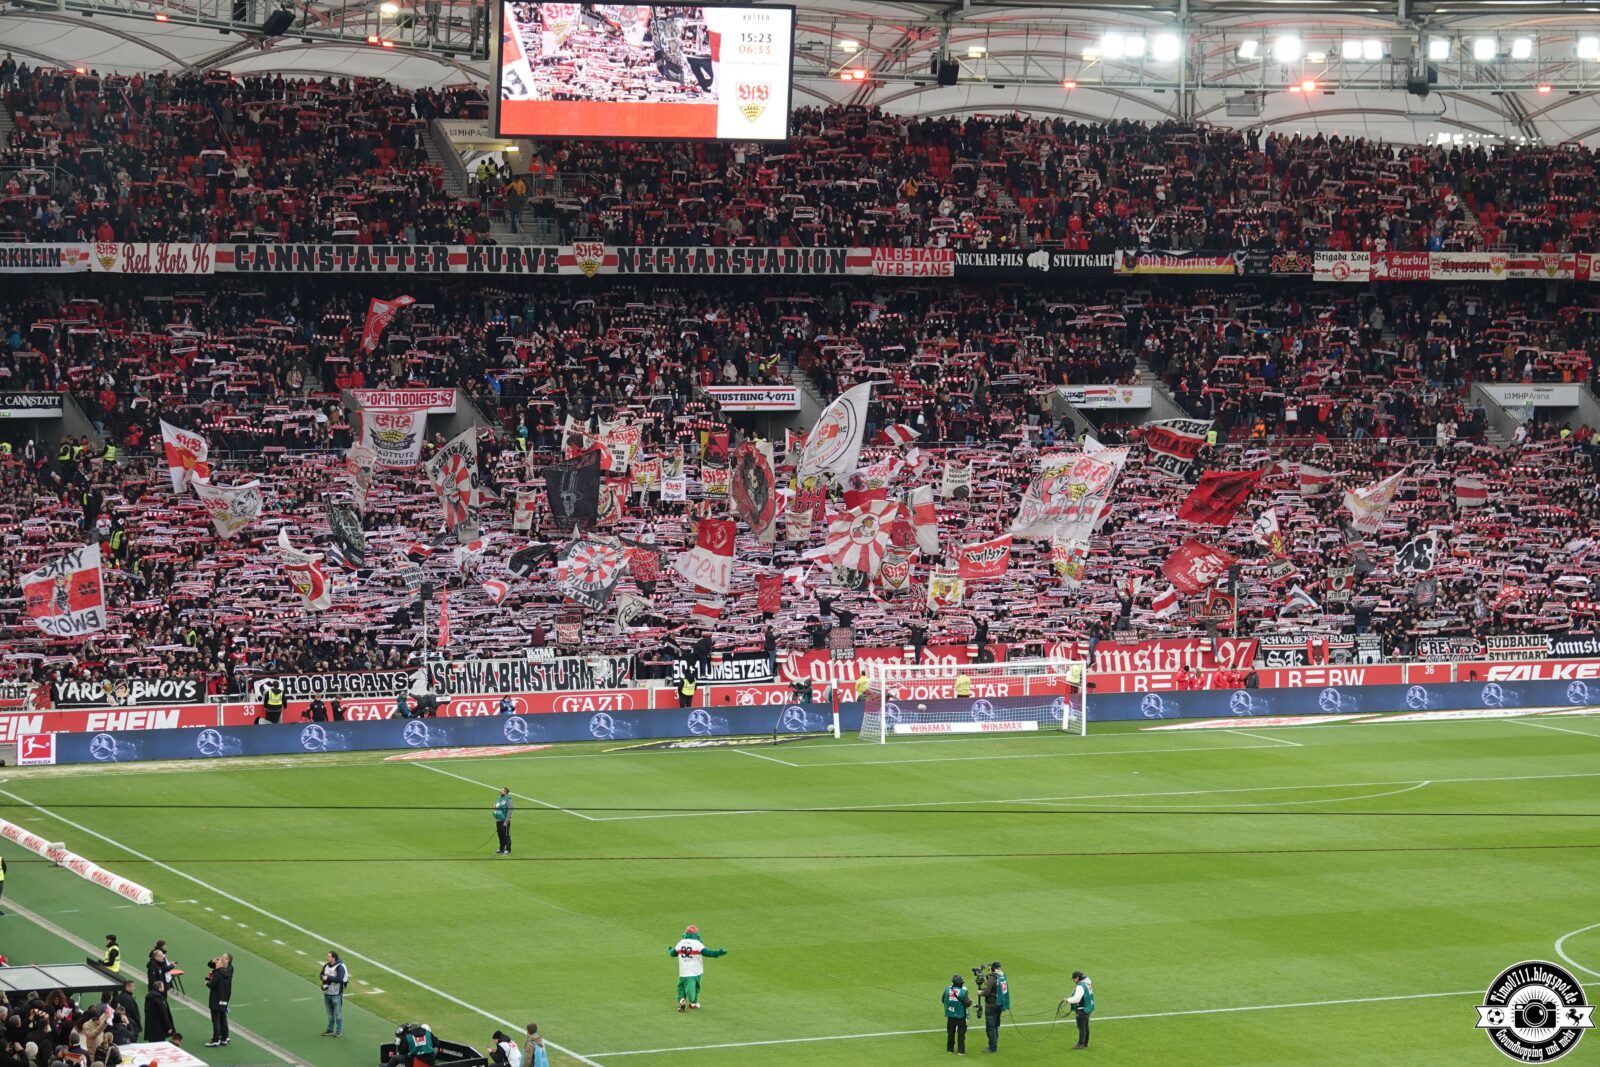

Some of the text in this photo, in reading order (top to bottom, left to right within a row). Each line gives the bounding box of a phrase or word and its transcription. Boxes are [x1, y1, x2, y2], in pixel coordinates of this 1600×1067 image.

[741, 33, 772, 43] 15:23
[738, 45, 771, 54] 06:33
[738, 84, 769, 101] VfB
[575, 242, 603, 257] VfB
[874, 248, 951, 261] ALBSTADT
[122, 243, 210, 273] Red Hots 96
[235, 245, 559, 273] CANNSTATTER KURVE
[617, 247, 847, 274] NECKARSTADION
[955, 252, 1115, 267] NECKAR-FILS STUTTGART
[1139, 253, 1218, 270] Old Warriors
[1315, 252, 1369, 262] Brigada Loca
[1392, 255, 1428, 266] Suebia
[876, 263, 951, 276] VFB-FANS
[1389, 267, 1430, 280] Ehingen
[5, 395, 59, 406] CANNSTATT
[371, 393, 437, 405] 0711 ADDICTS
[775, 393, 795, 401] 0711
[1487, 635, 1547, 648] SÜDBANDE
[1542, 636, 1600, 655] Cannst
[1420, 642, 1460, 655] CREW
[1488, 649, 1548, 661] STUTTGART
[1214, 641, 1253, 672] 97
[433, 657, 595, 695] SCHWABENSTURM
[1424, 665, 1435, 675] 36
[54, 678, 197, 701] YARD BWOYS
[281, 671, 408, 696] HOOLIGANS
[243, 705, 255, 716] 33
[86, 708, 180, 732] EHEIM
[909, 723, 953, 733] WINAMAX
[980, 722, 1023, 732] WINAMAX
[681, 946, 693, 959] 92
